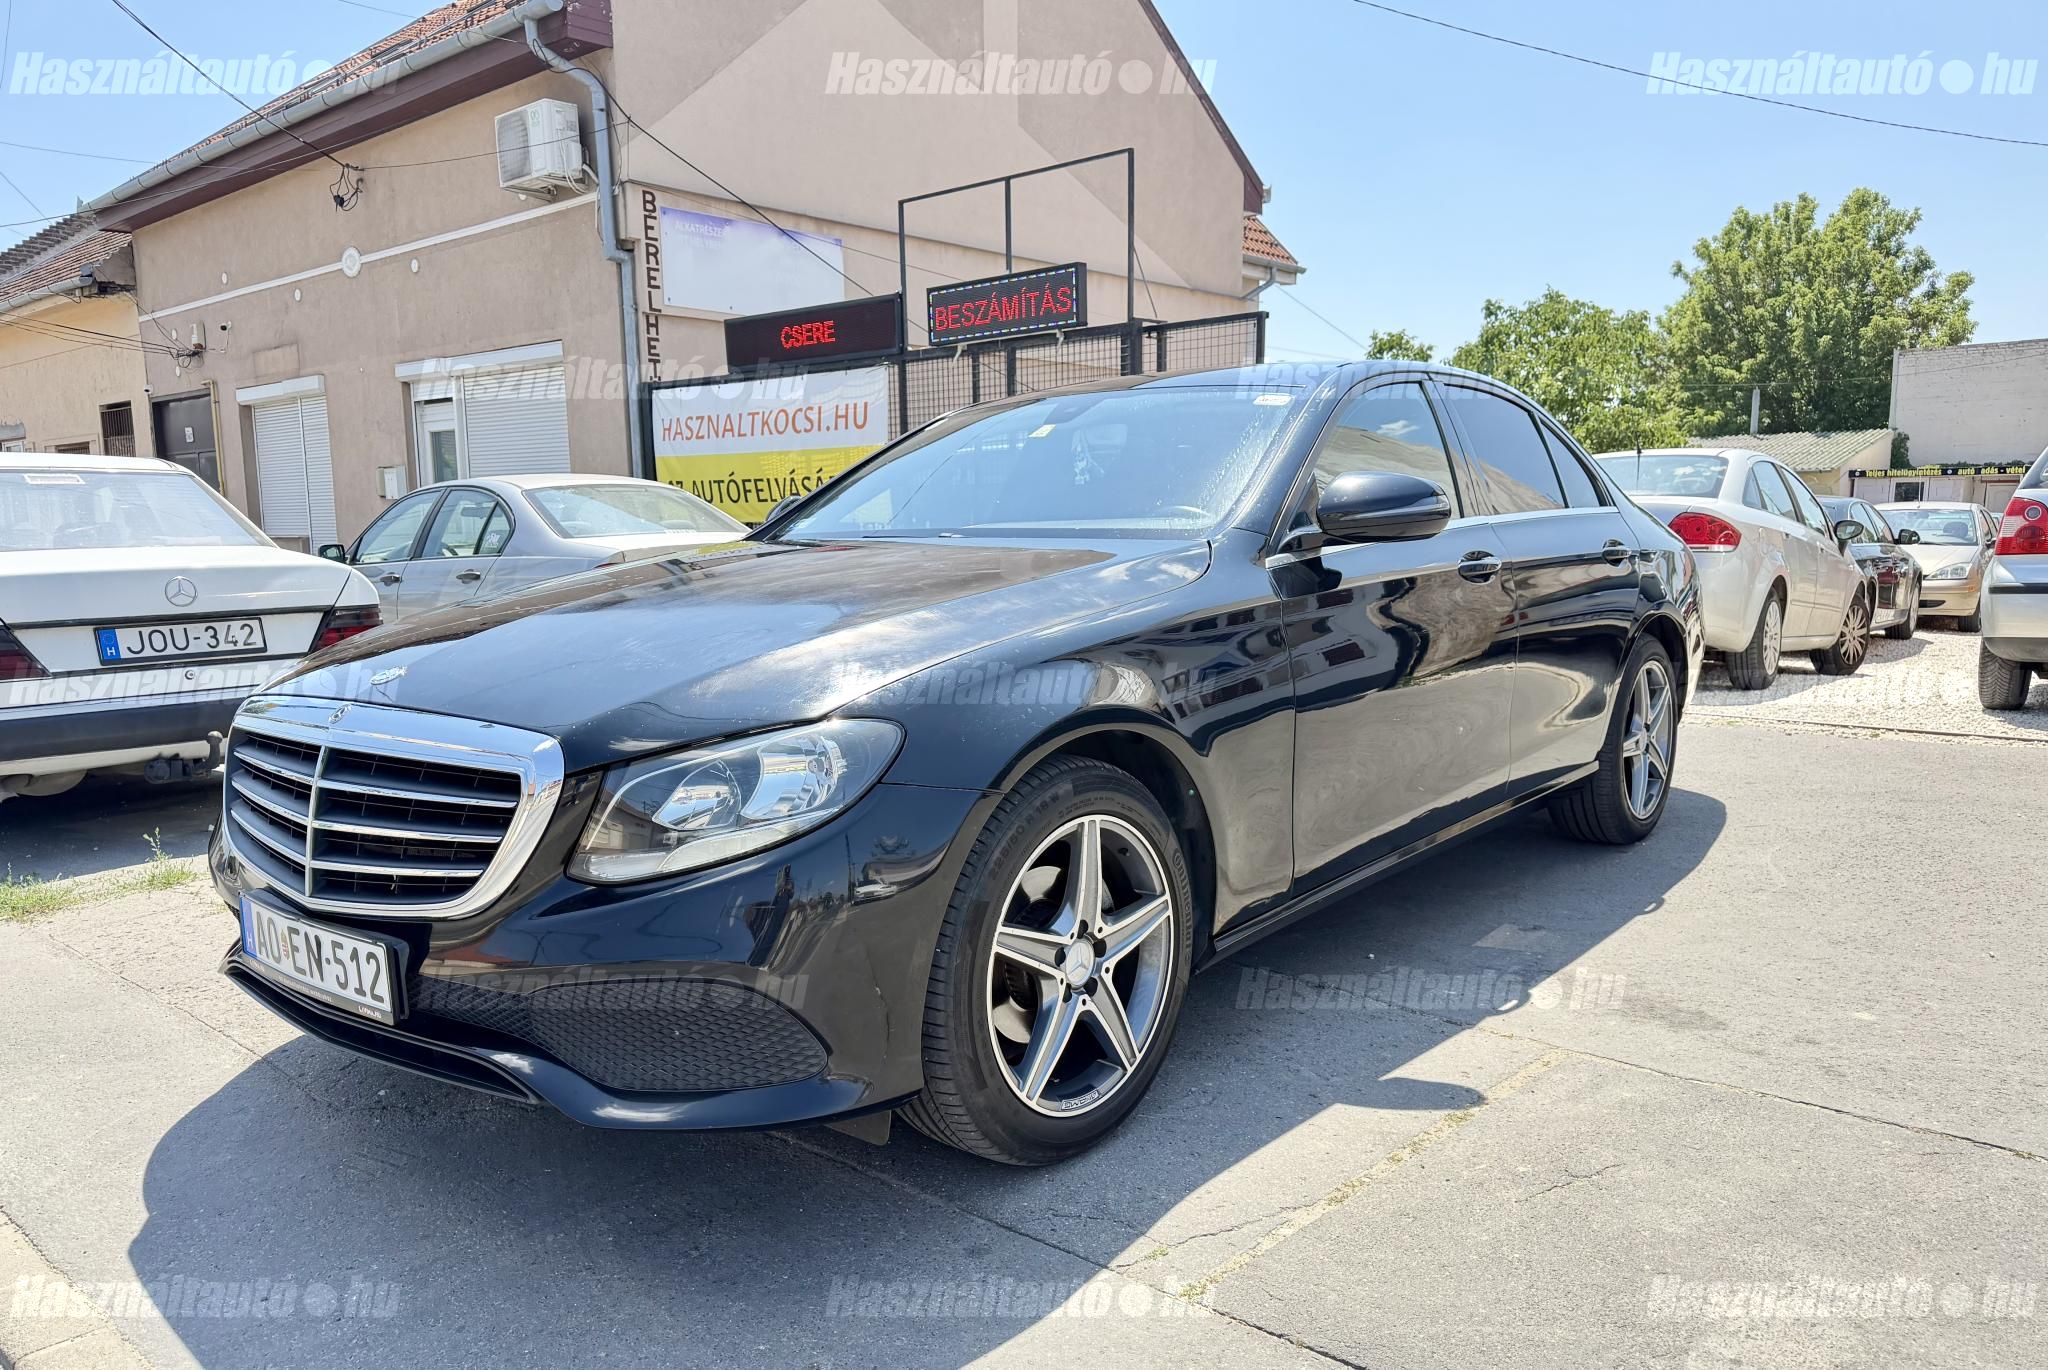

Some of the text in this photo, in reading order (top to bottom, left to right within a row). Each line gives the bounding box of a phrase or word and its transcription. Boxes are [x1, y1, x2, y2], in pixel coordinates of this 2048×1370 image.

[641, 189, 663, 382] BERELHET
[935, 282, 1072, 332] BESZÁMÍTÁS
[781, 320, 836, 350] CSERE
[661, 401, 869, 442] HASZNALTKOCSI.HU
[692, 467, 836, 504] AUTÓFELVÁSÁ
[107, 623, 258, 656] H JOU-342
